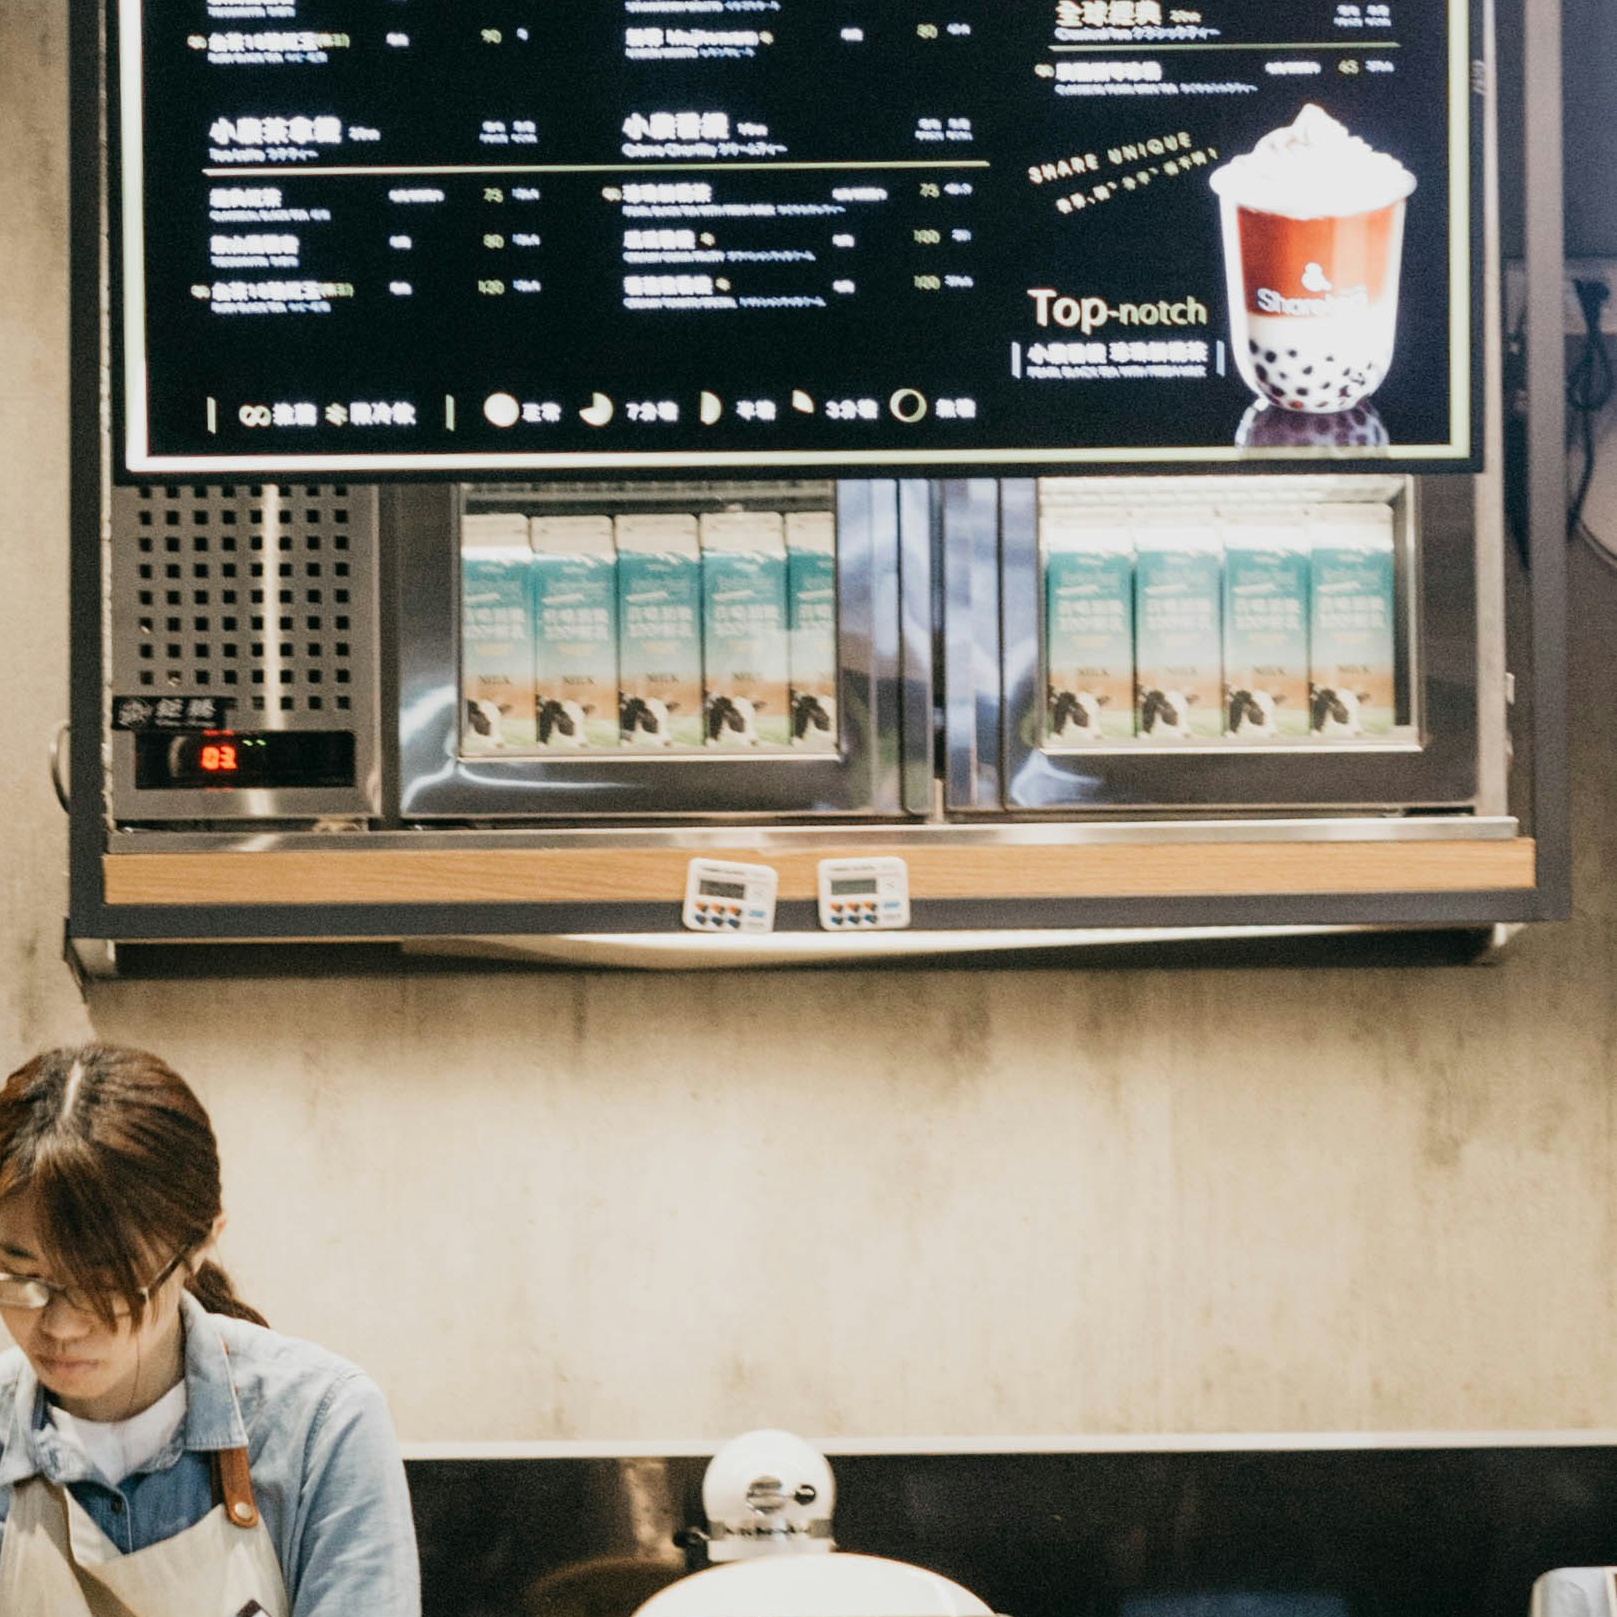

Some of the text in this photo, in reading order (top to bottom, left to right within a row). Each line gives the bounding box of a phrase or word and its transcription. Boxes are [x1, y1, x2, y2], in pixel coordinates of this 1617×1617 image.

[1028, 153, 1099, 184] SHARE
[1107, 132, 1192, 165] UNIQUE
[1027, 288, 1209, 335] Top-notch
